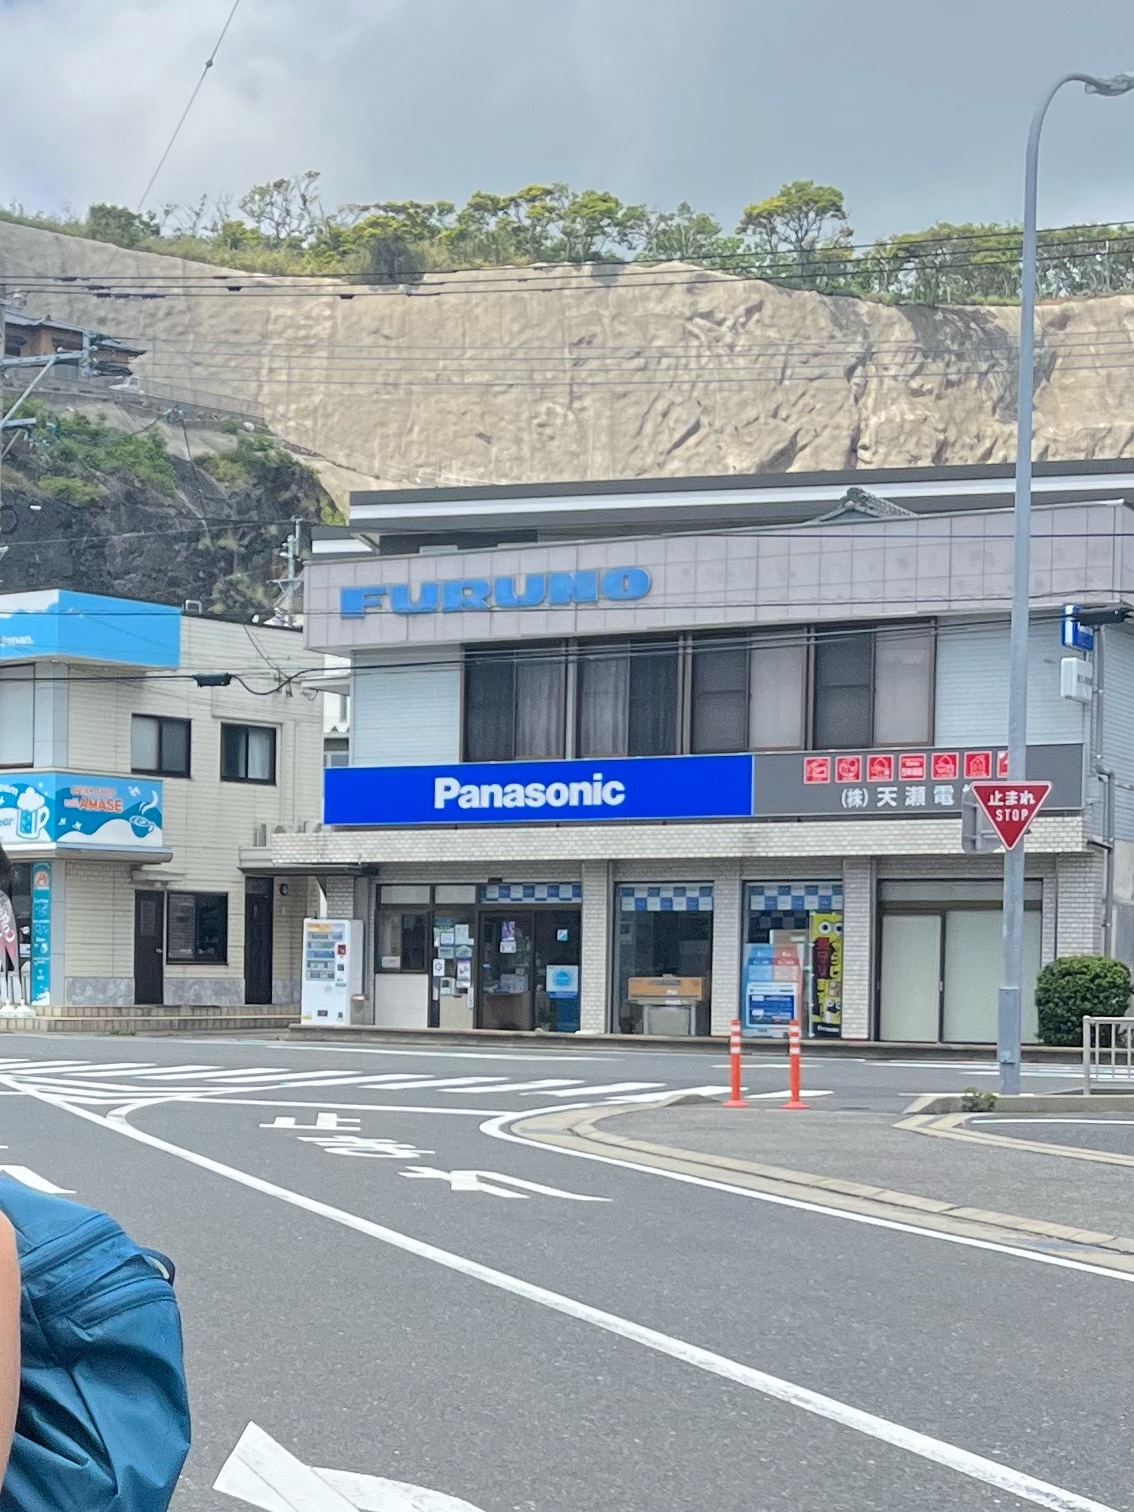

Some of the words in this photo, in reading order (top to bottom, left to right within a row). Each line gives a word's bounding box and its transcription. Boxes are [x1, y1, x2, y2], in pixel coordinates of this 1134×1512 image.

[340, 567, 652, 620] FURUNO
[434, 772, 626, 809] Panasonic
[987, 789, 1036, 807] 止まれ
[80, 797, 122, 812] AMASE
[995, 808, 1029, 822] STOP
